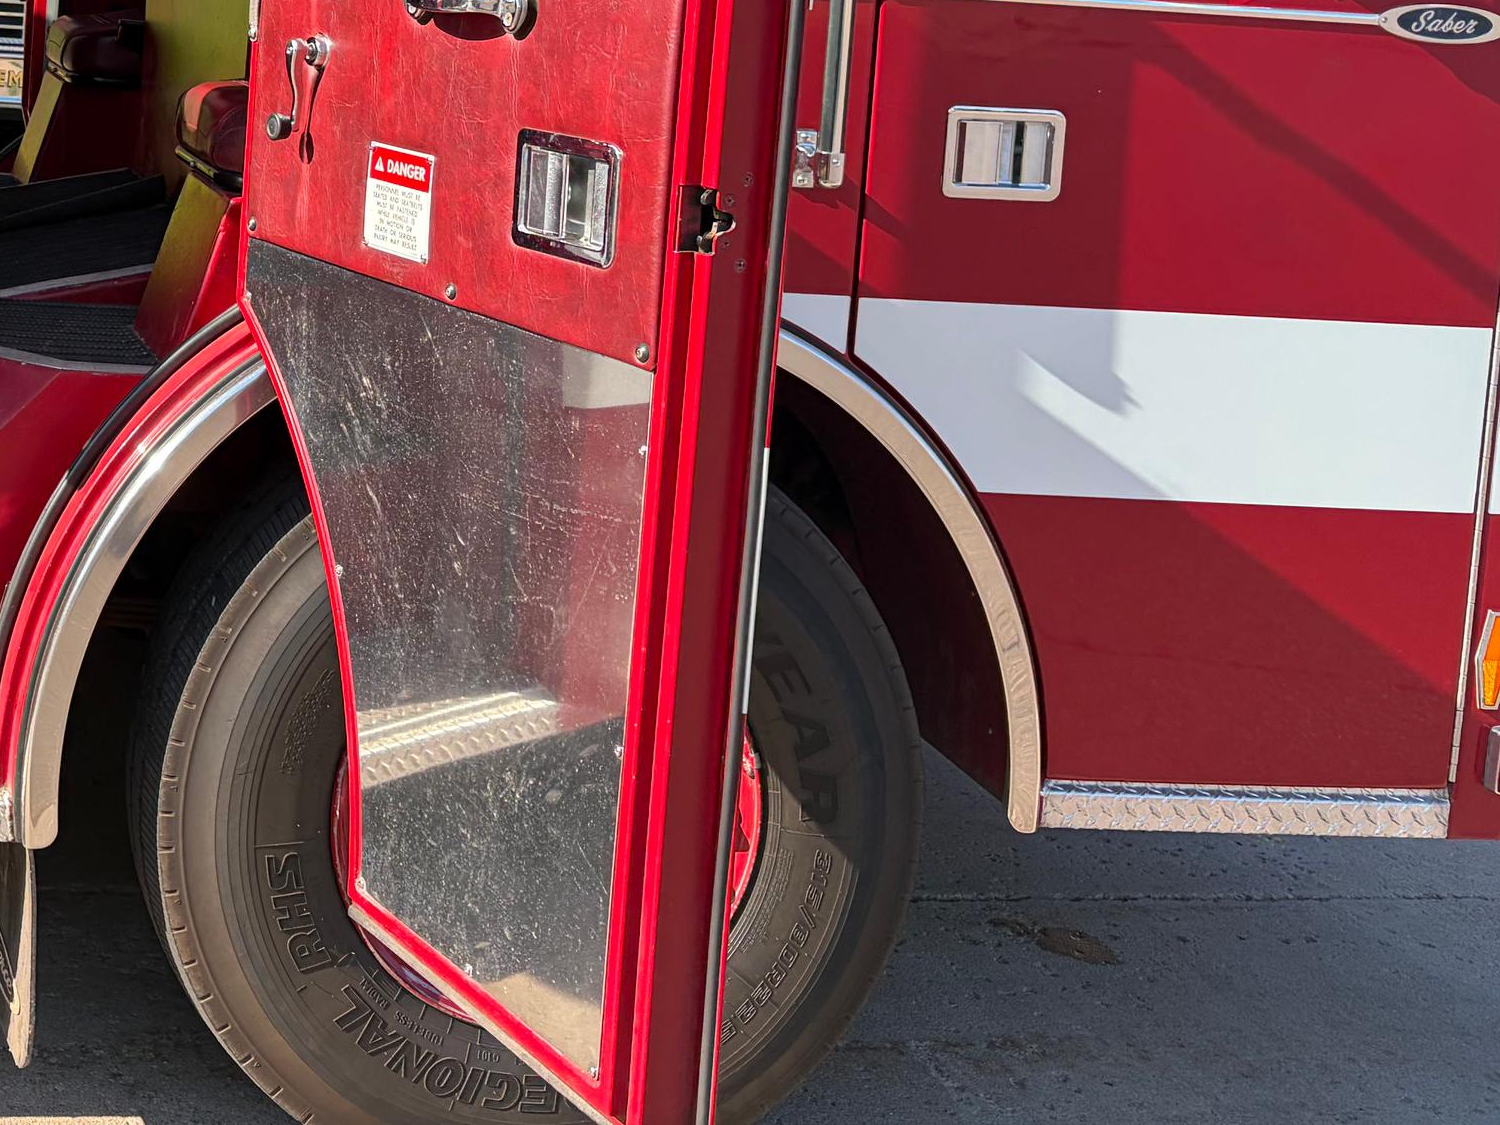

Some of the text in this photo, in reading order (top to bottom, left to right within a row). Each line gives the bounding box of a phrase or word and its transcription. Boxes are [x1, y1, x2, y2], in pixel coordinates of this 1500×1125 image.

[1411, 9, 1479, 35] Saber
[386, 158, 426, 182] DANGER
[386, 220, 403, 230] MOTION
[264, 851, 572, 1115] EGIONAL RHS
